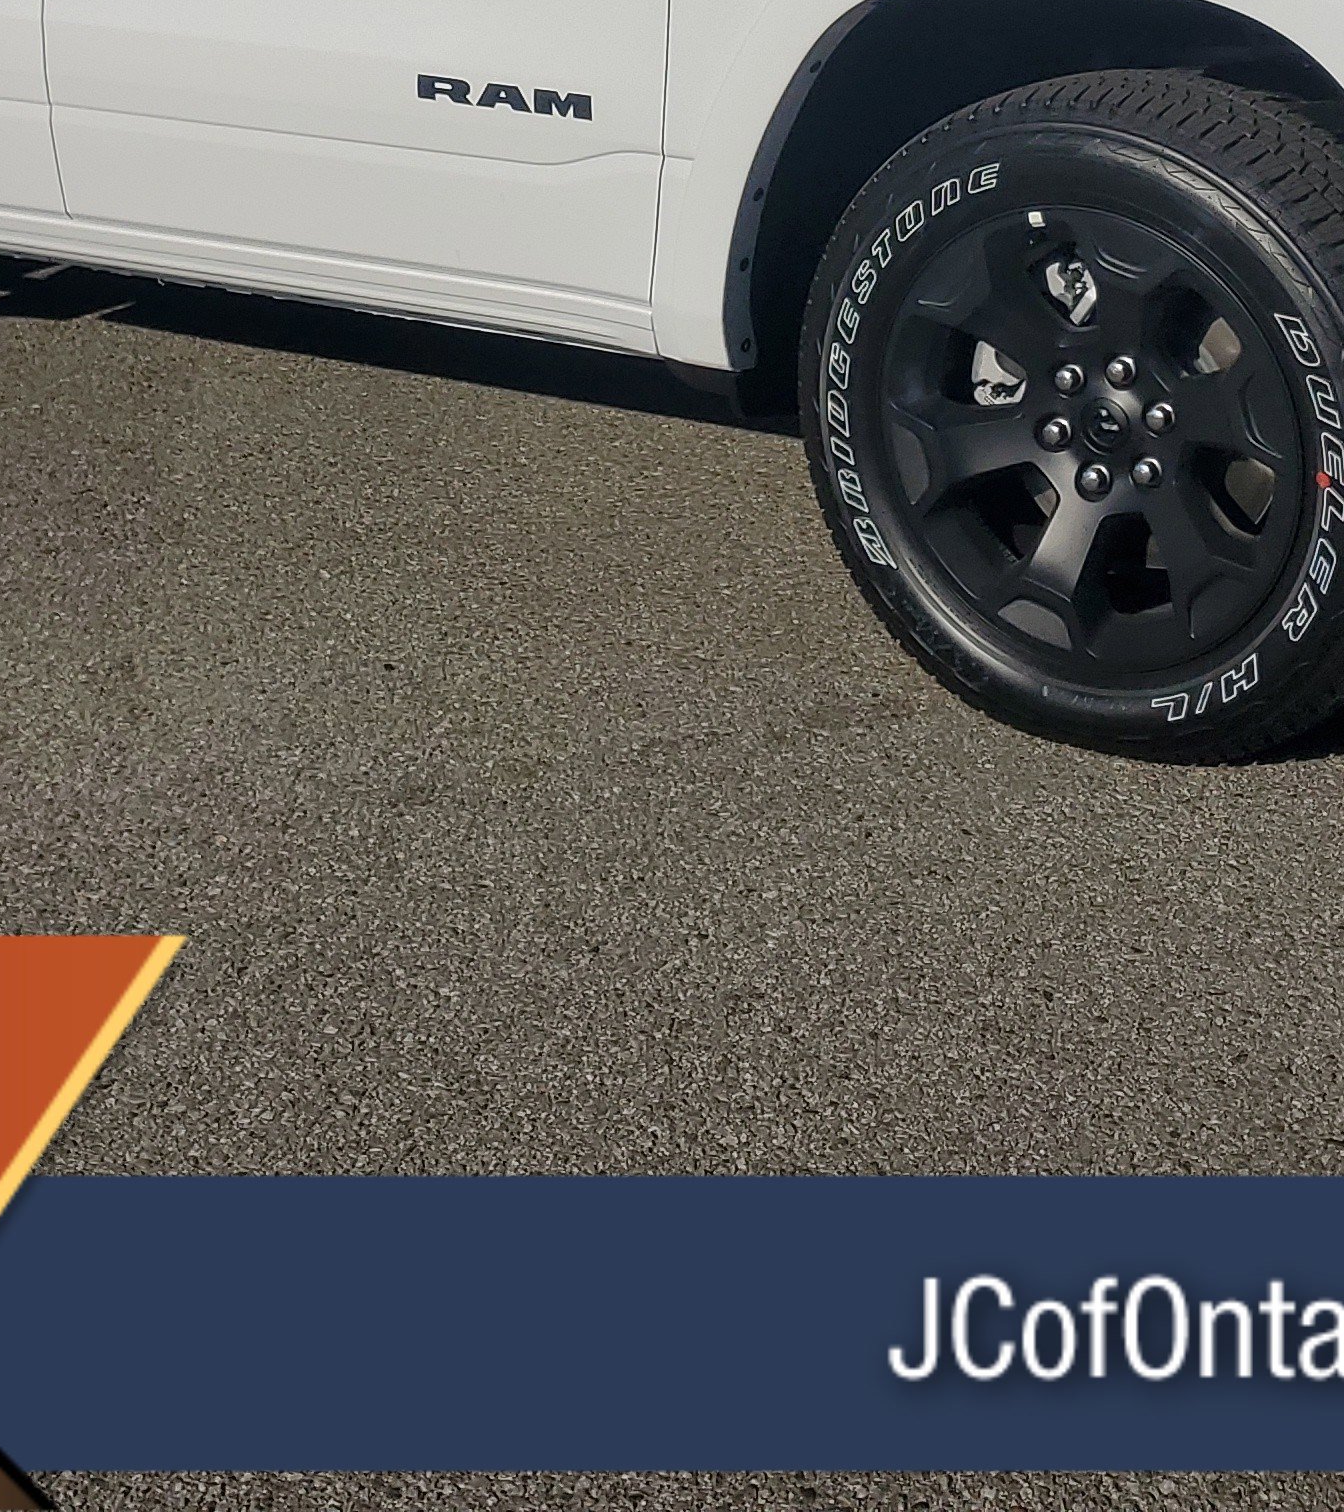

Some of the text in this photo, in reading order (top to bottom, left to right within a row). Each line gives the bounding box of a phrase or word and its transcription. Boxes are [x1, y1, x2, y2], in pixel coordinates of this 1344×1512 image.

[416, 73, 593, 122] RAM
[826, 162, 1001, 570] BRIDGESTONE
[1150, 653, 1259, 723] H/L
